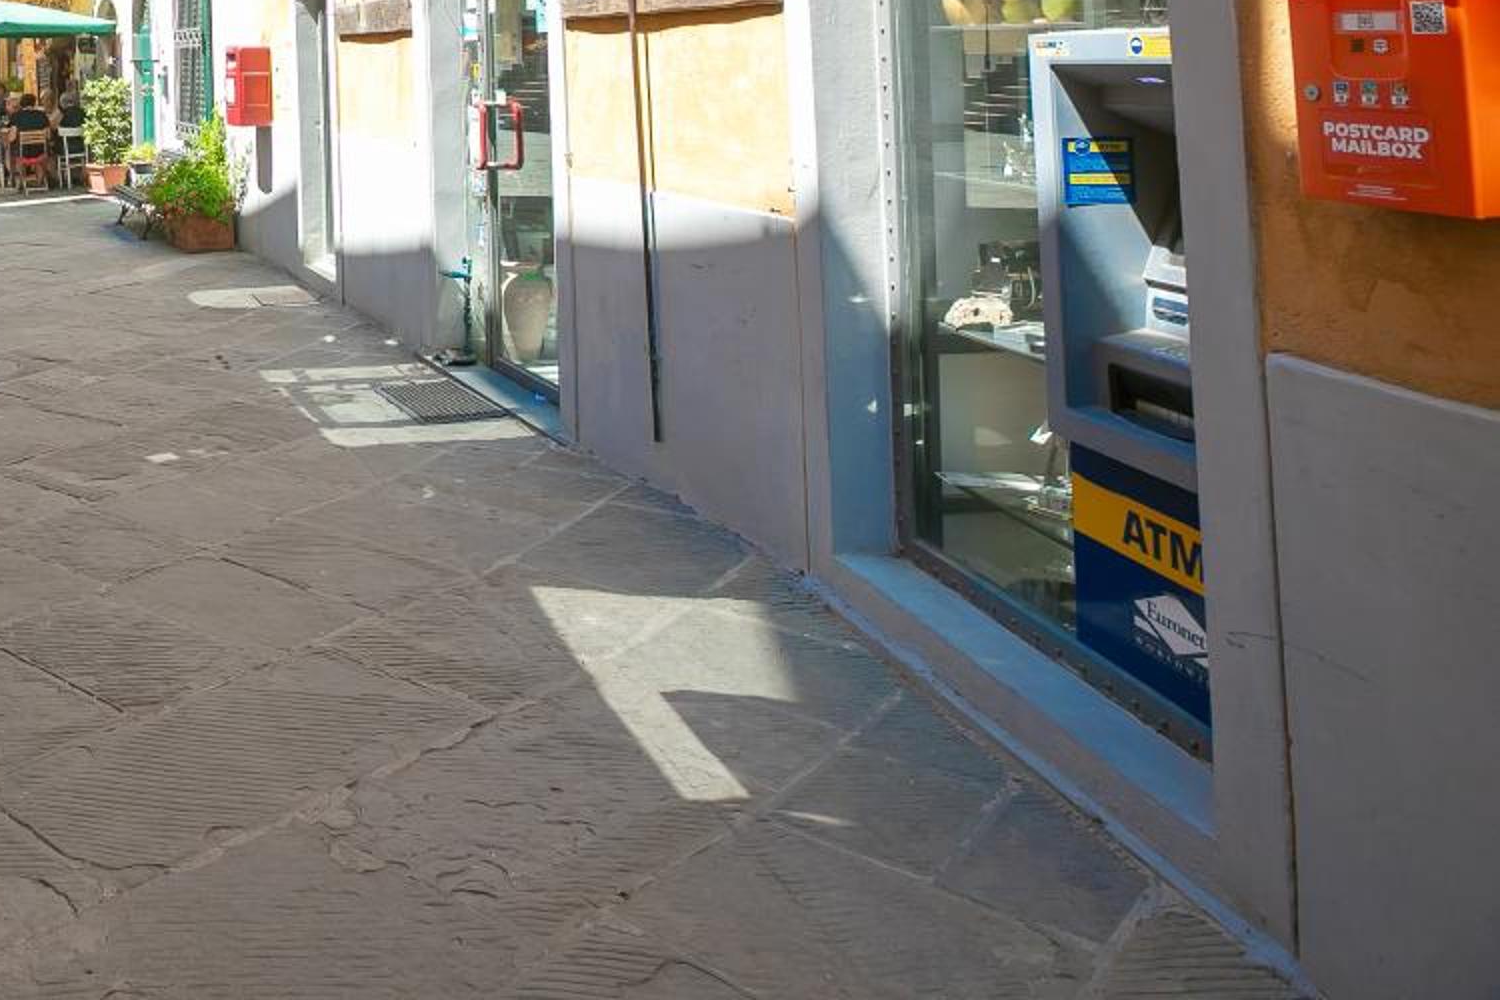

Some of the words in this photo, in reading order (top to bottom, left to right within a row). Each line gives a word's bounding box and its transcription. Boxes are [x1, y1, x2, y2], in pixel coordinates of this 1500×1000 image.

[1322, 121, 1430, 143] POSTCARD
[1330, 137, 1423, 159] MAILBOX
[1122, 509, 1206, 585] ATM
[1146, 599, 1206, 650] Euronet
